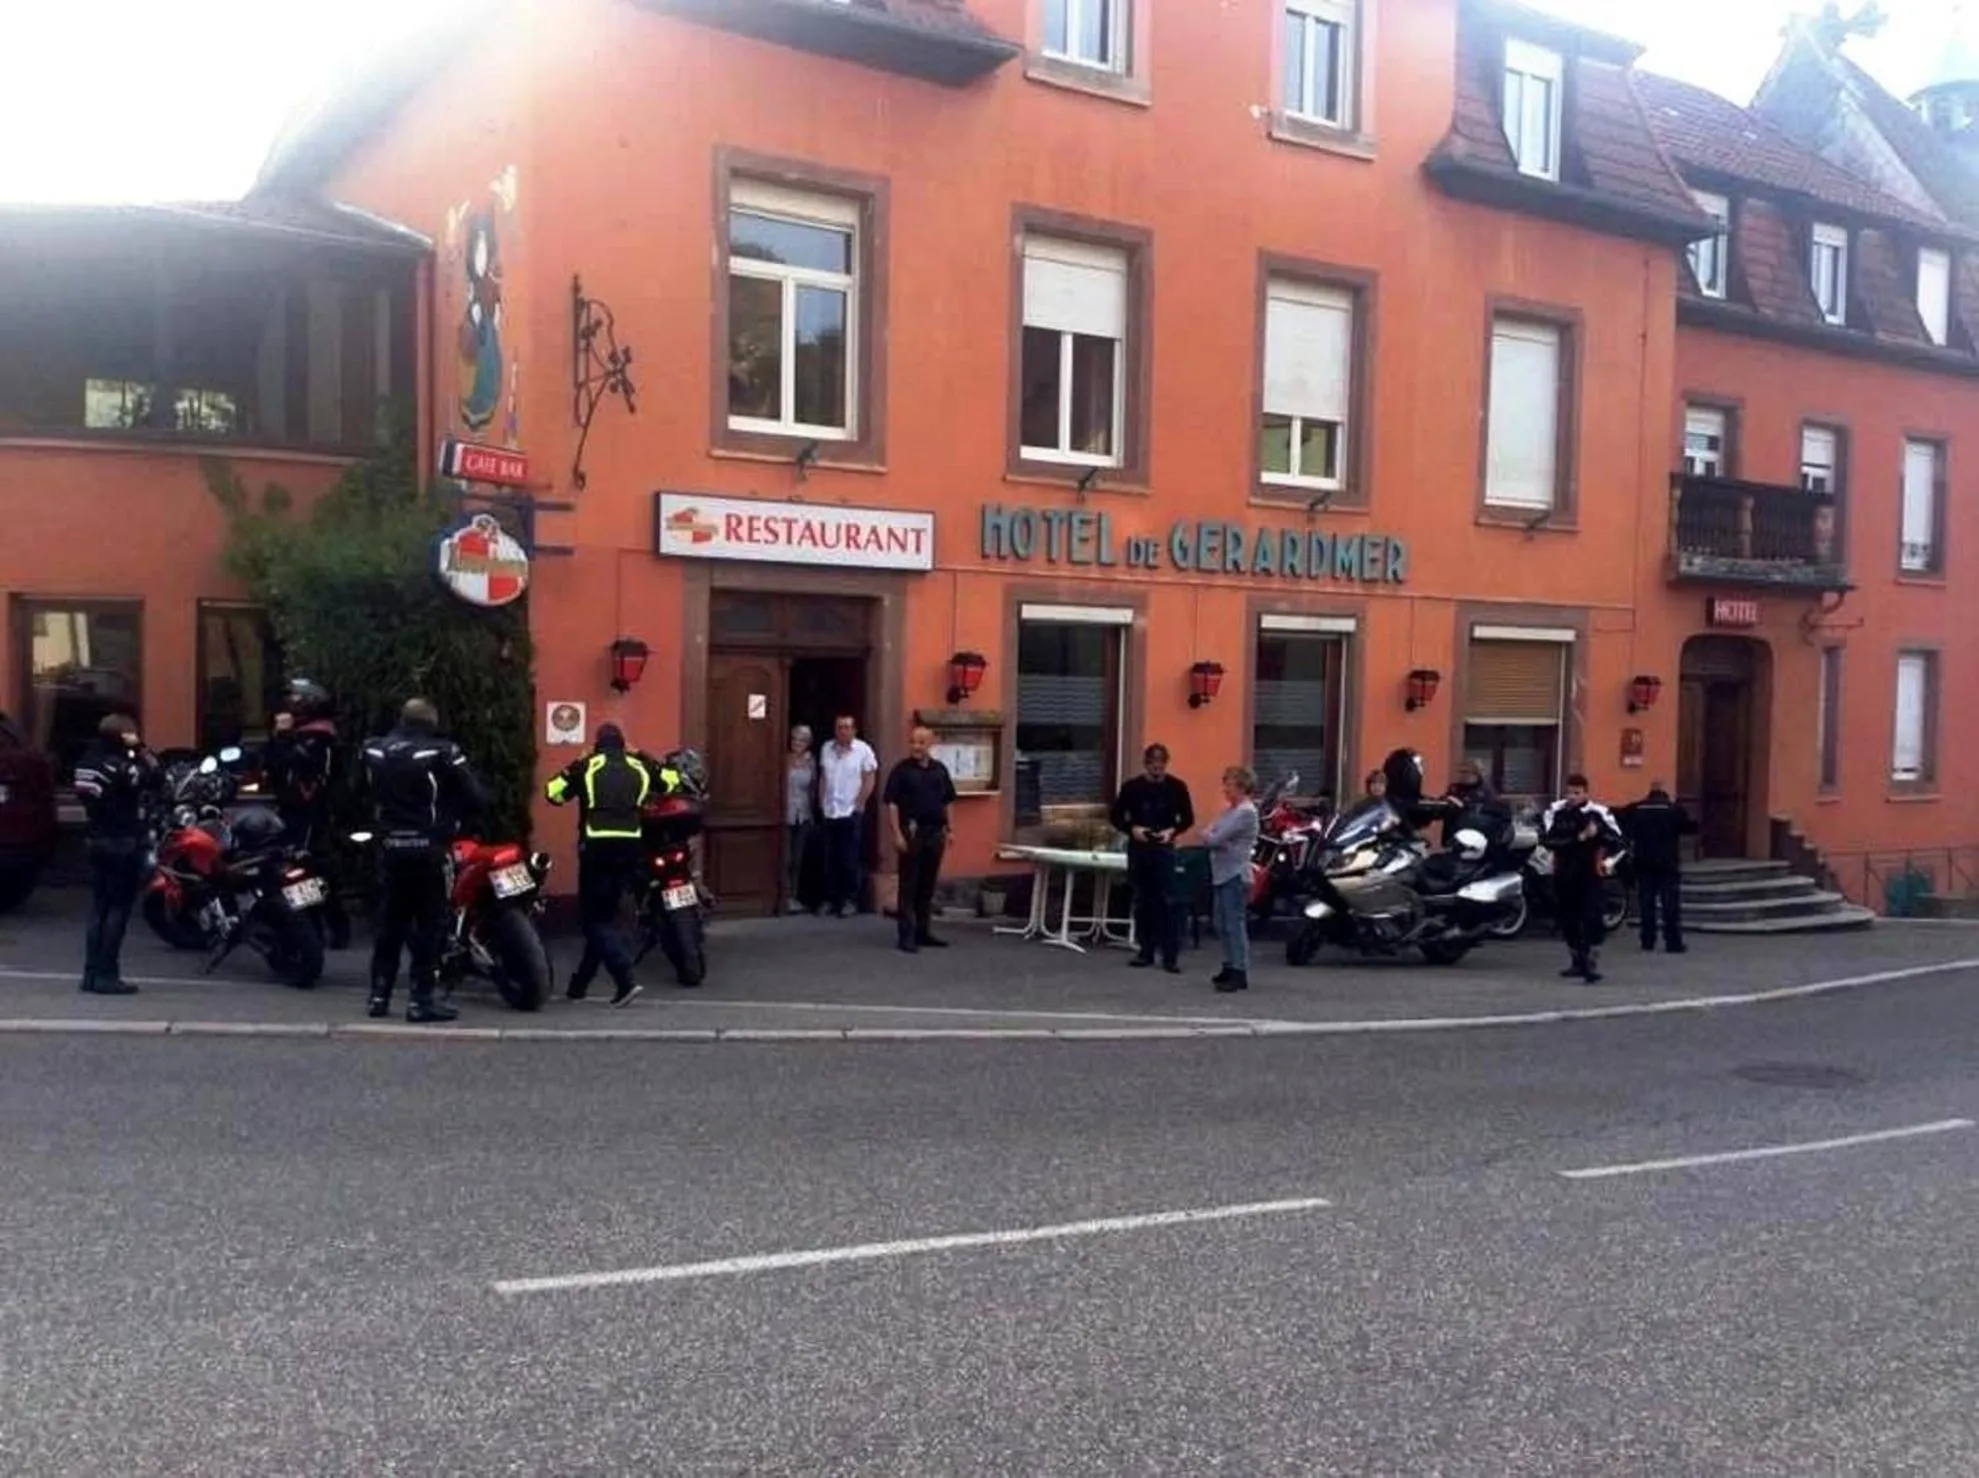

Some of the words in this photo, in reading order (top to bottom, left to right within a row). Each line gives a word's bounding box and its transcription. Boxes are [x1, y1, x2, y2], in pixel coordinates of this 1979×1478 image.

[499, 459, 525, 479] BAR
[724, 512, 928, 556] RESTAURANT
[981, 503, 1117, 568] HOTEL
[1126, 535, 1160, 570] DE
[1168, 518, 1406, 584] GERARDMER
[1714, 599, 1758, 622] HOTEL
